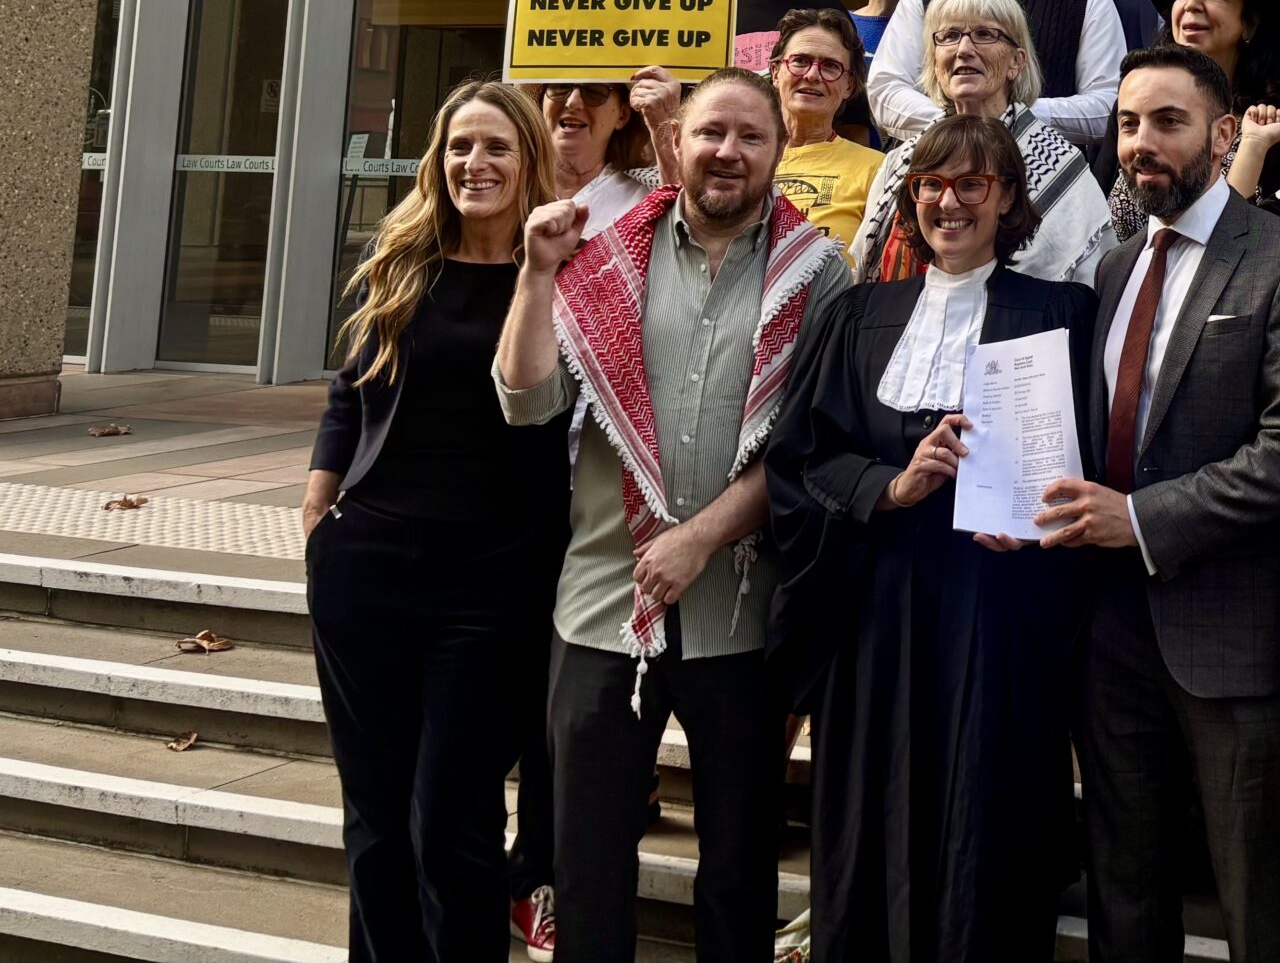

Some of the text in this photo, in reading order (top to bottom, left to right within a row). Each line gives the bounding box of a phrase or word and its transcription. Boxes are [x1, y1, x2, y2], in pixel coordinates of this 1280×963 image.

[527, 29, 712, 48] NEVER GIVE UP
[87, 155, 107, 168] Cour
[181, 157, 198, 169] Law
[200, 157, 225, 170] Courts
[226, 158, 243, 170] Law
[243, 158, 270, 171] Courts
[362, 160, 390, 174] Courts
[391, 161, 408, 174] Law
